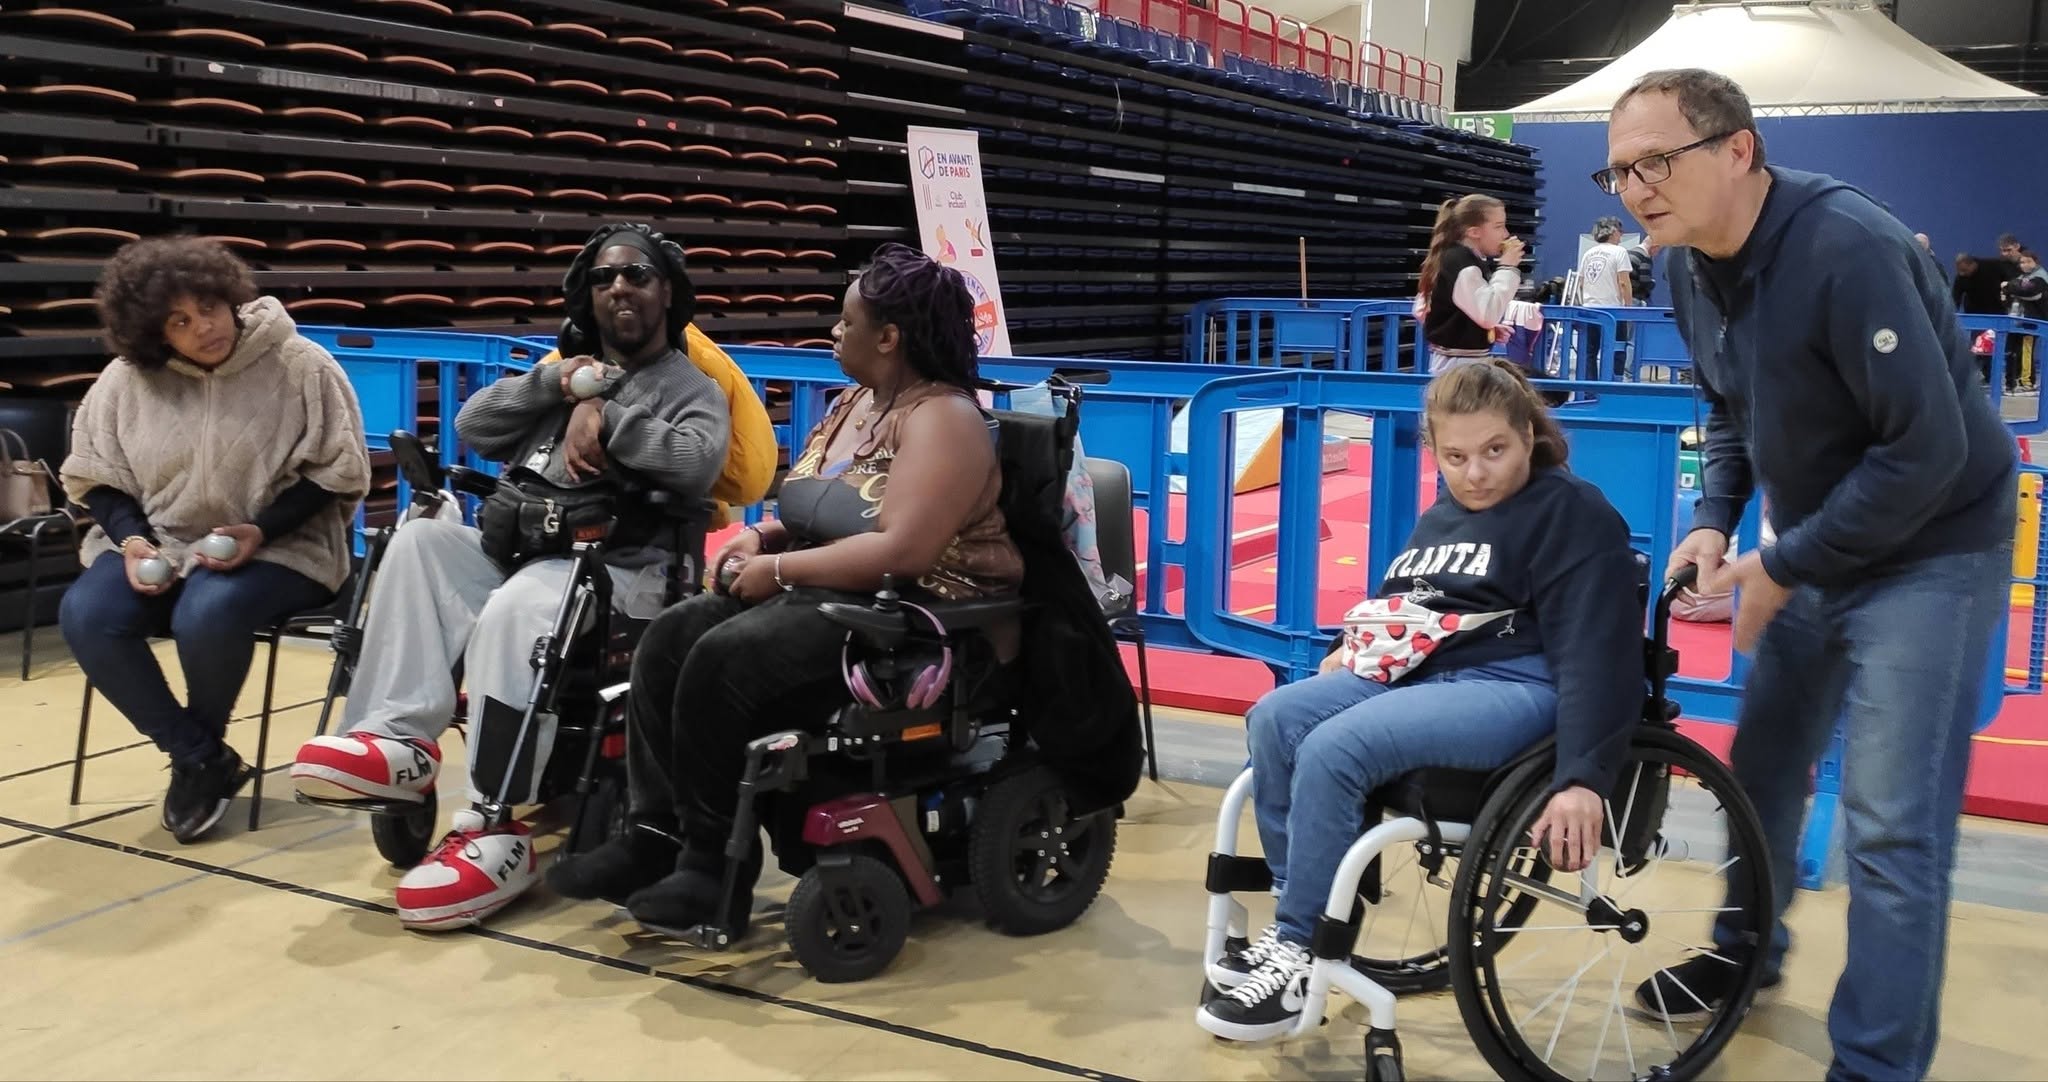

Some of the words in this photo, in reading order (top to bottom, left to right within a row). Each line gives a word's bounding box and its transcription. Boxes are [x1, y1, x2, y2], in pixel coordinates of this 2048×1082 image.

[936, 152, 948, 164] EN
[949, 153, 974, 166] AVANT!
[938, 166, 949, 177] DE
[950, 166, 971, 178] PARIS
[396, 764, 432, 784] FLM
[497, 841, 526, 882] FLM
